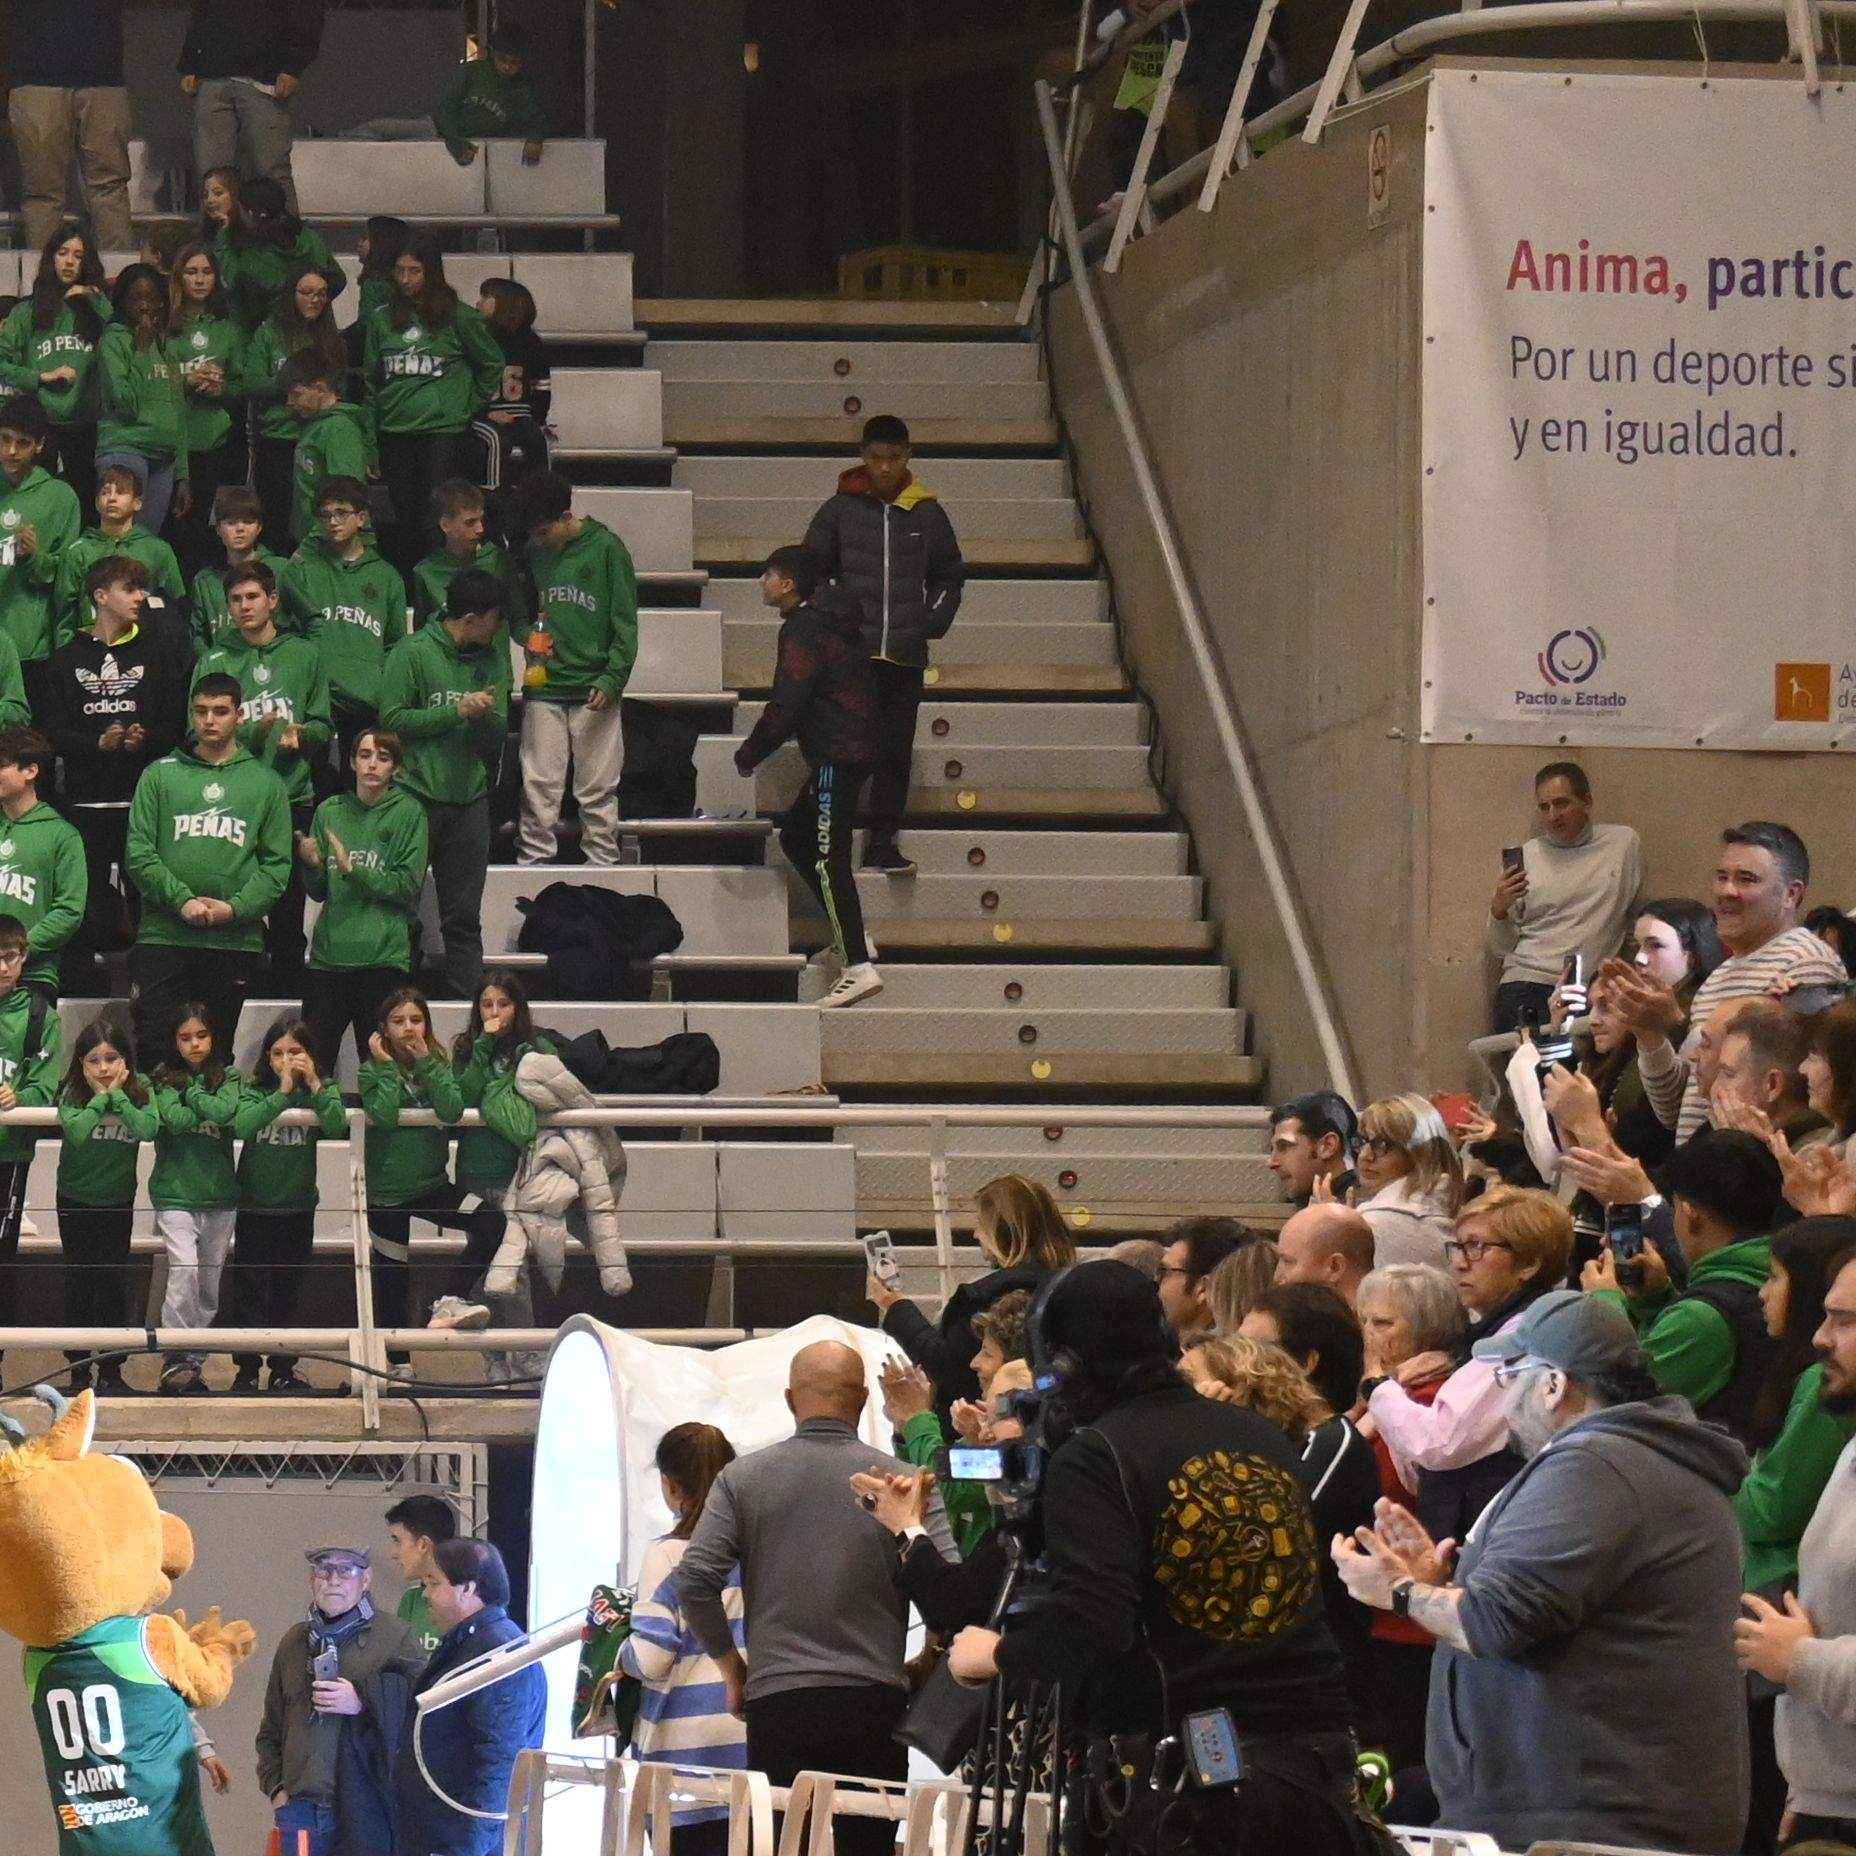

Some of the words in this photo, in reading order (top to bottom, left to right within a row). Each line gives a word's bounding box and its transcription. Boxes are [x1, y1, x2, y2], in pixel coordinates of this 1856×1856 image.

[1506, 239, 1687, 304] Anima,
[1708, 245, 1855, 310] partic
[1510, 336, 1575, 381] Por
[1589, 348, 1637, 382] un
[1653, 338, 1814, 396] deporte
[1510, 417, 1530, 461] y
[1541, 419, 1587, 452] en
[1605, 408, 1797, 465] igualdad.
[548, 585, 596, 613] PEÑAS
[335, 605, 382, 638] PEÑAS
[83, 699, 137, 716] adidas
[1515, 690, 1558, 705] Pacto
[1575, 691, 1627, 707] Estado
[173, 806, 248, 848] PEÑAS
[817, 792, 833, 855] ADIDAS
[46, 1683, 126, 1760] 00
[64, 1763, 126, 1796] SARRY
[75, 1796, 139, 1816] GOBIERNO
